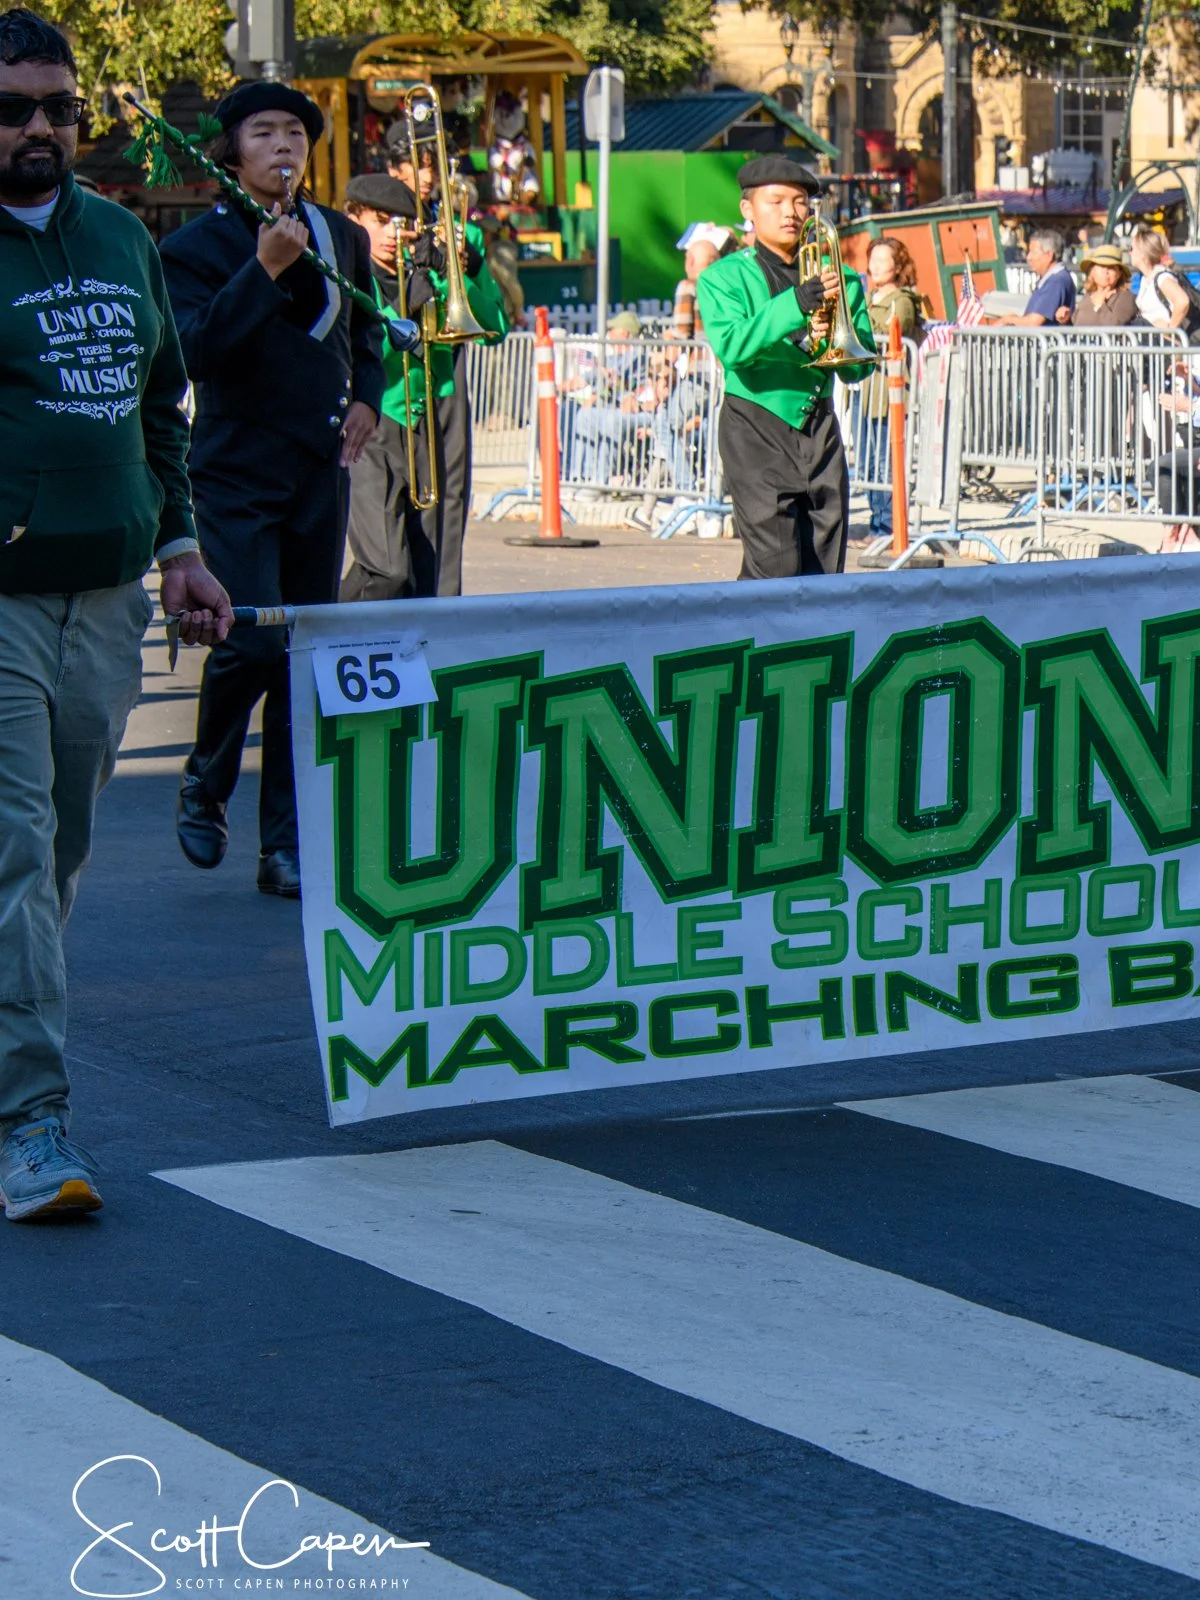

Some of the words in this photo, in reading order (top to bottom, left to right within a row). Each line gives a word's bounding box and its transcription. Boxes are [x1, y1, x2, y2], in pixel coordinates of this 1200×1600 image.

[37, 302, 136, 334] UNION
[49, 331, 87, 346] MIDDLE
[91, 328, 134, 338] CHOOL
[77, 343, 113, 356] TIGERS
[58, 361, 138, 394] MUSIC
[336, 652, 401, 703] 65
[324, 901, 744, 1022] MIDDLE
[328, 953, 1081, 1102] MARCHING
